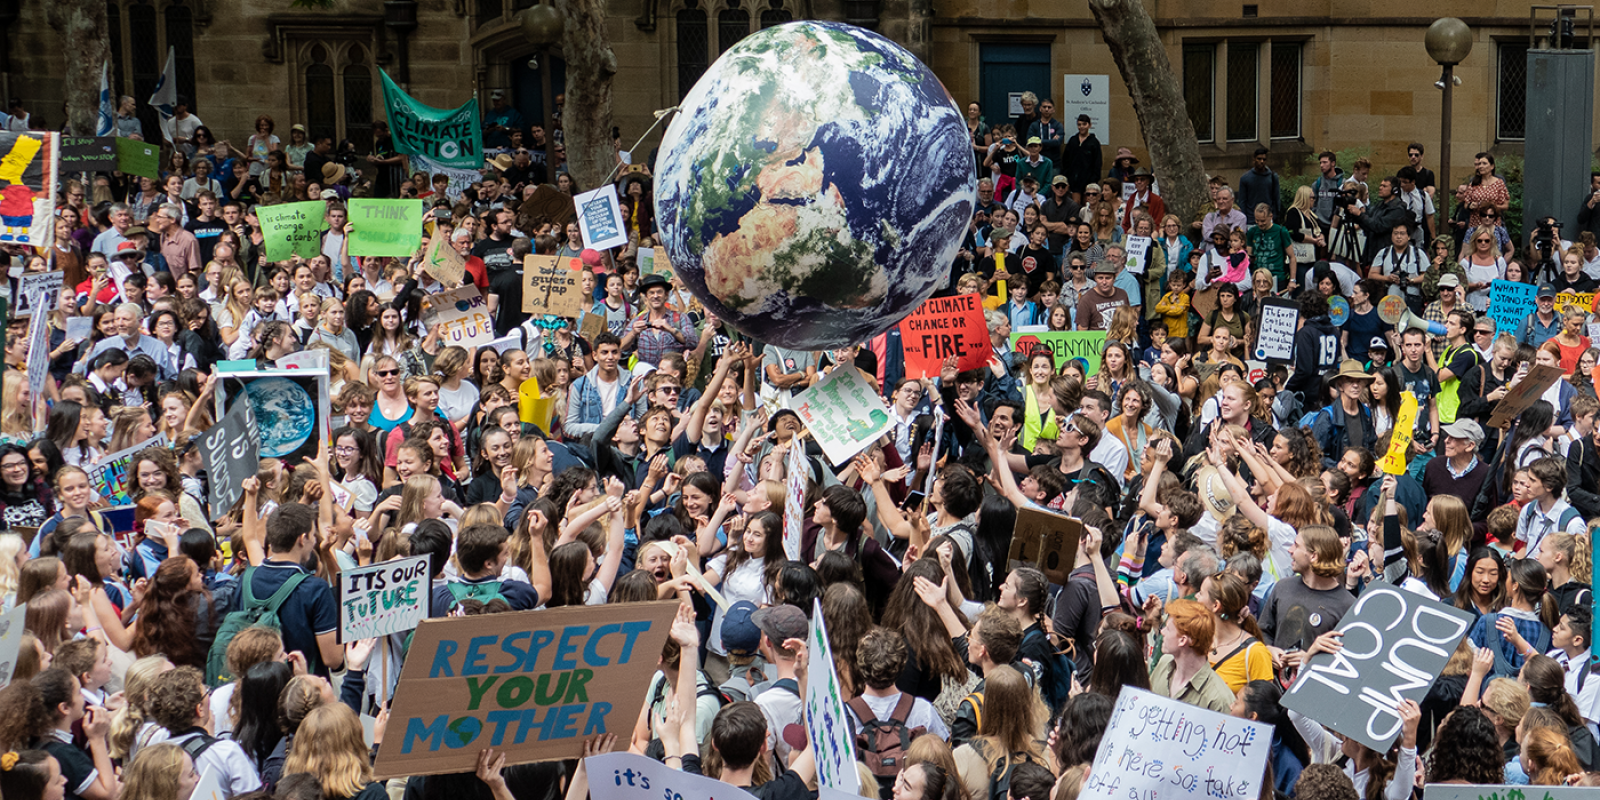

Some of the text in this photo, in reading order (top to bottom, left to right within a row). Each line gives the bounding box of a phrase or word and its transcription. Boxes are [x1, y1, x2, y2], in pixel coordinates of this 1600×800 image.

[394, 111, 472, 139] CLIMATE
[398, 127, 474, 159] ACTION
[275, 209, 306, 221] climate
[361, 205, 410, 221] THINK
[274, 223, 304, 234] change
[294, 229, 320, 242] carb?
[1494, 283, 1530, 296] WHAT I
[1495, 294, 1521, 305] STAND
[911, 296, 975, 317] TOP CLIMATE
[1493, 305, 1501, 313] IS
[1503, 306, 1524, 315] WHAT
[909, 317, 966, 331] CHANGE OR
[922, 334, 967, 359] FIRE
[1318, 335, 1337, 365] 19
[230, 432, 249, 459] IS
[206, 427, 235, 515] SUICIDE
[391, 560, 427, 583] OUR
[343, 580, 419, 623] FUTURE
[429, 621, 652, 678] RESPECT
[1290, 588, 1408, 695] COAL
[1358, 605, 1467, 741] DUMP
[467, 669, 594, 710] YOUR
[401, 702, 613, 754] MOTHER
[1129, 704, 1208, 758] getting
[1212, 722, 1252, 757] hot
[614, 768, 650, 790] it's
[1089, 772, 1121, 792] off
[1119, 744, 1166, 783] here,
[1170, 766, 1195, 791] so
[1205, 769, 1250, 797] take
